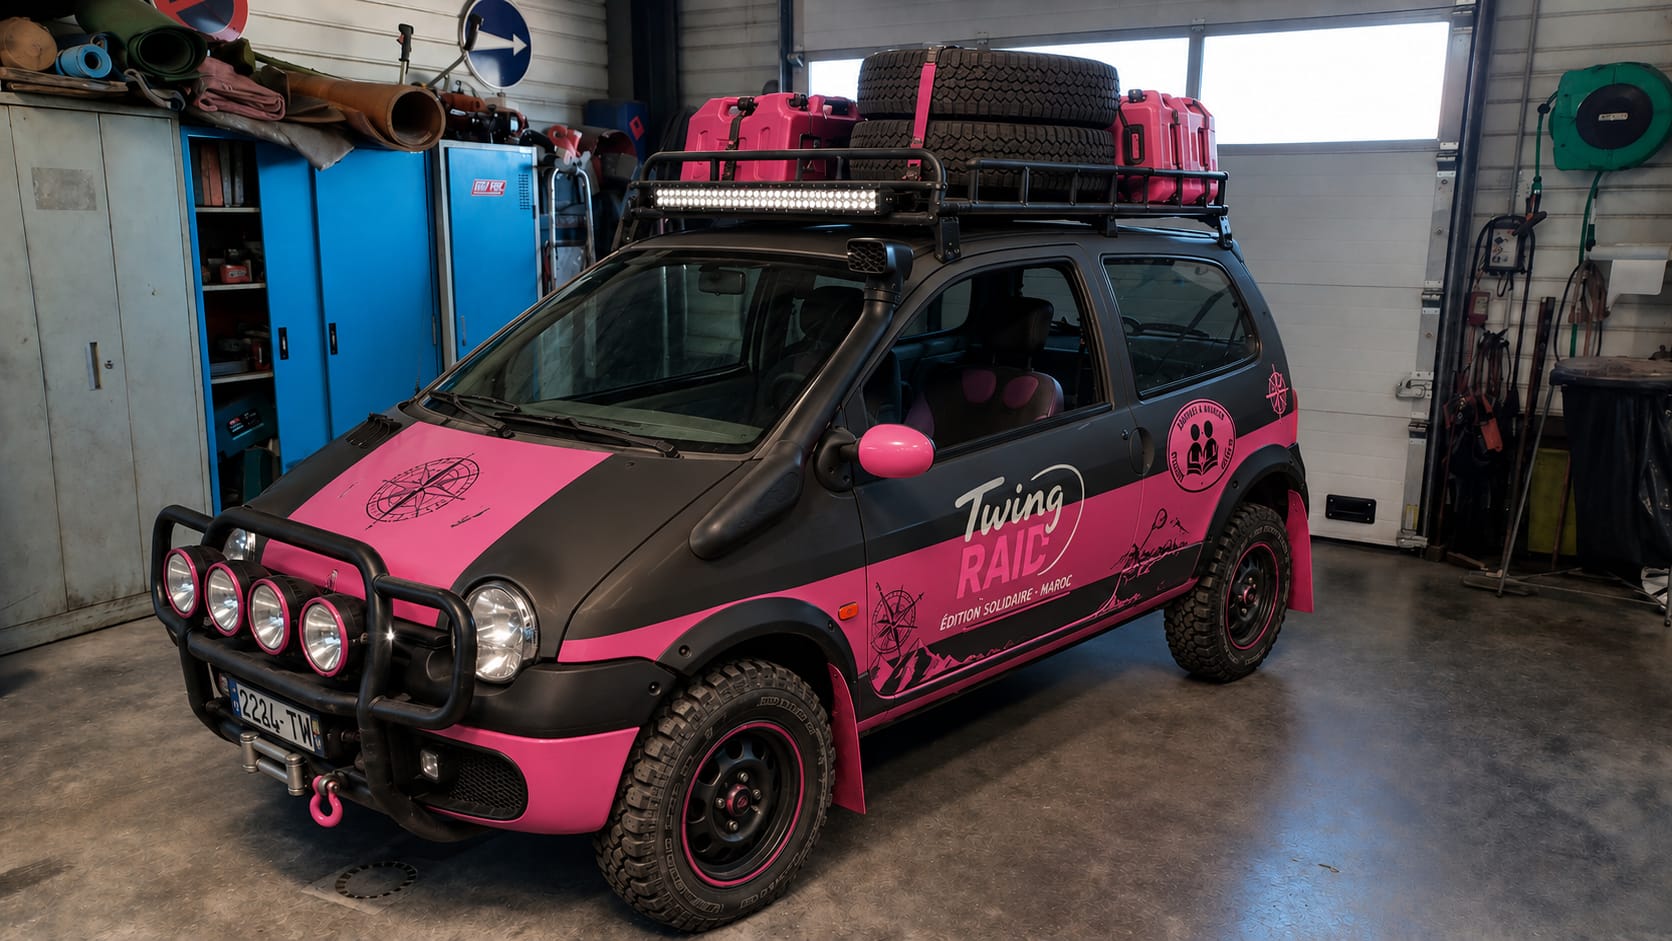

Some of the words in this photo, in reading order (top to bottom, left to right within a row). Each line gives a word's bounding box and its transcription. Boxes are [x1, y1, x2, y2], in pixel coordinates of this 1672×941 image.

[955, 476, 1063, 543] Twing
[940, 607, 981, 631] ÉDITION
[984, 588, 1034, 616] SOLIDAIRE
[1040, 574, 1073, 597] MAROC
